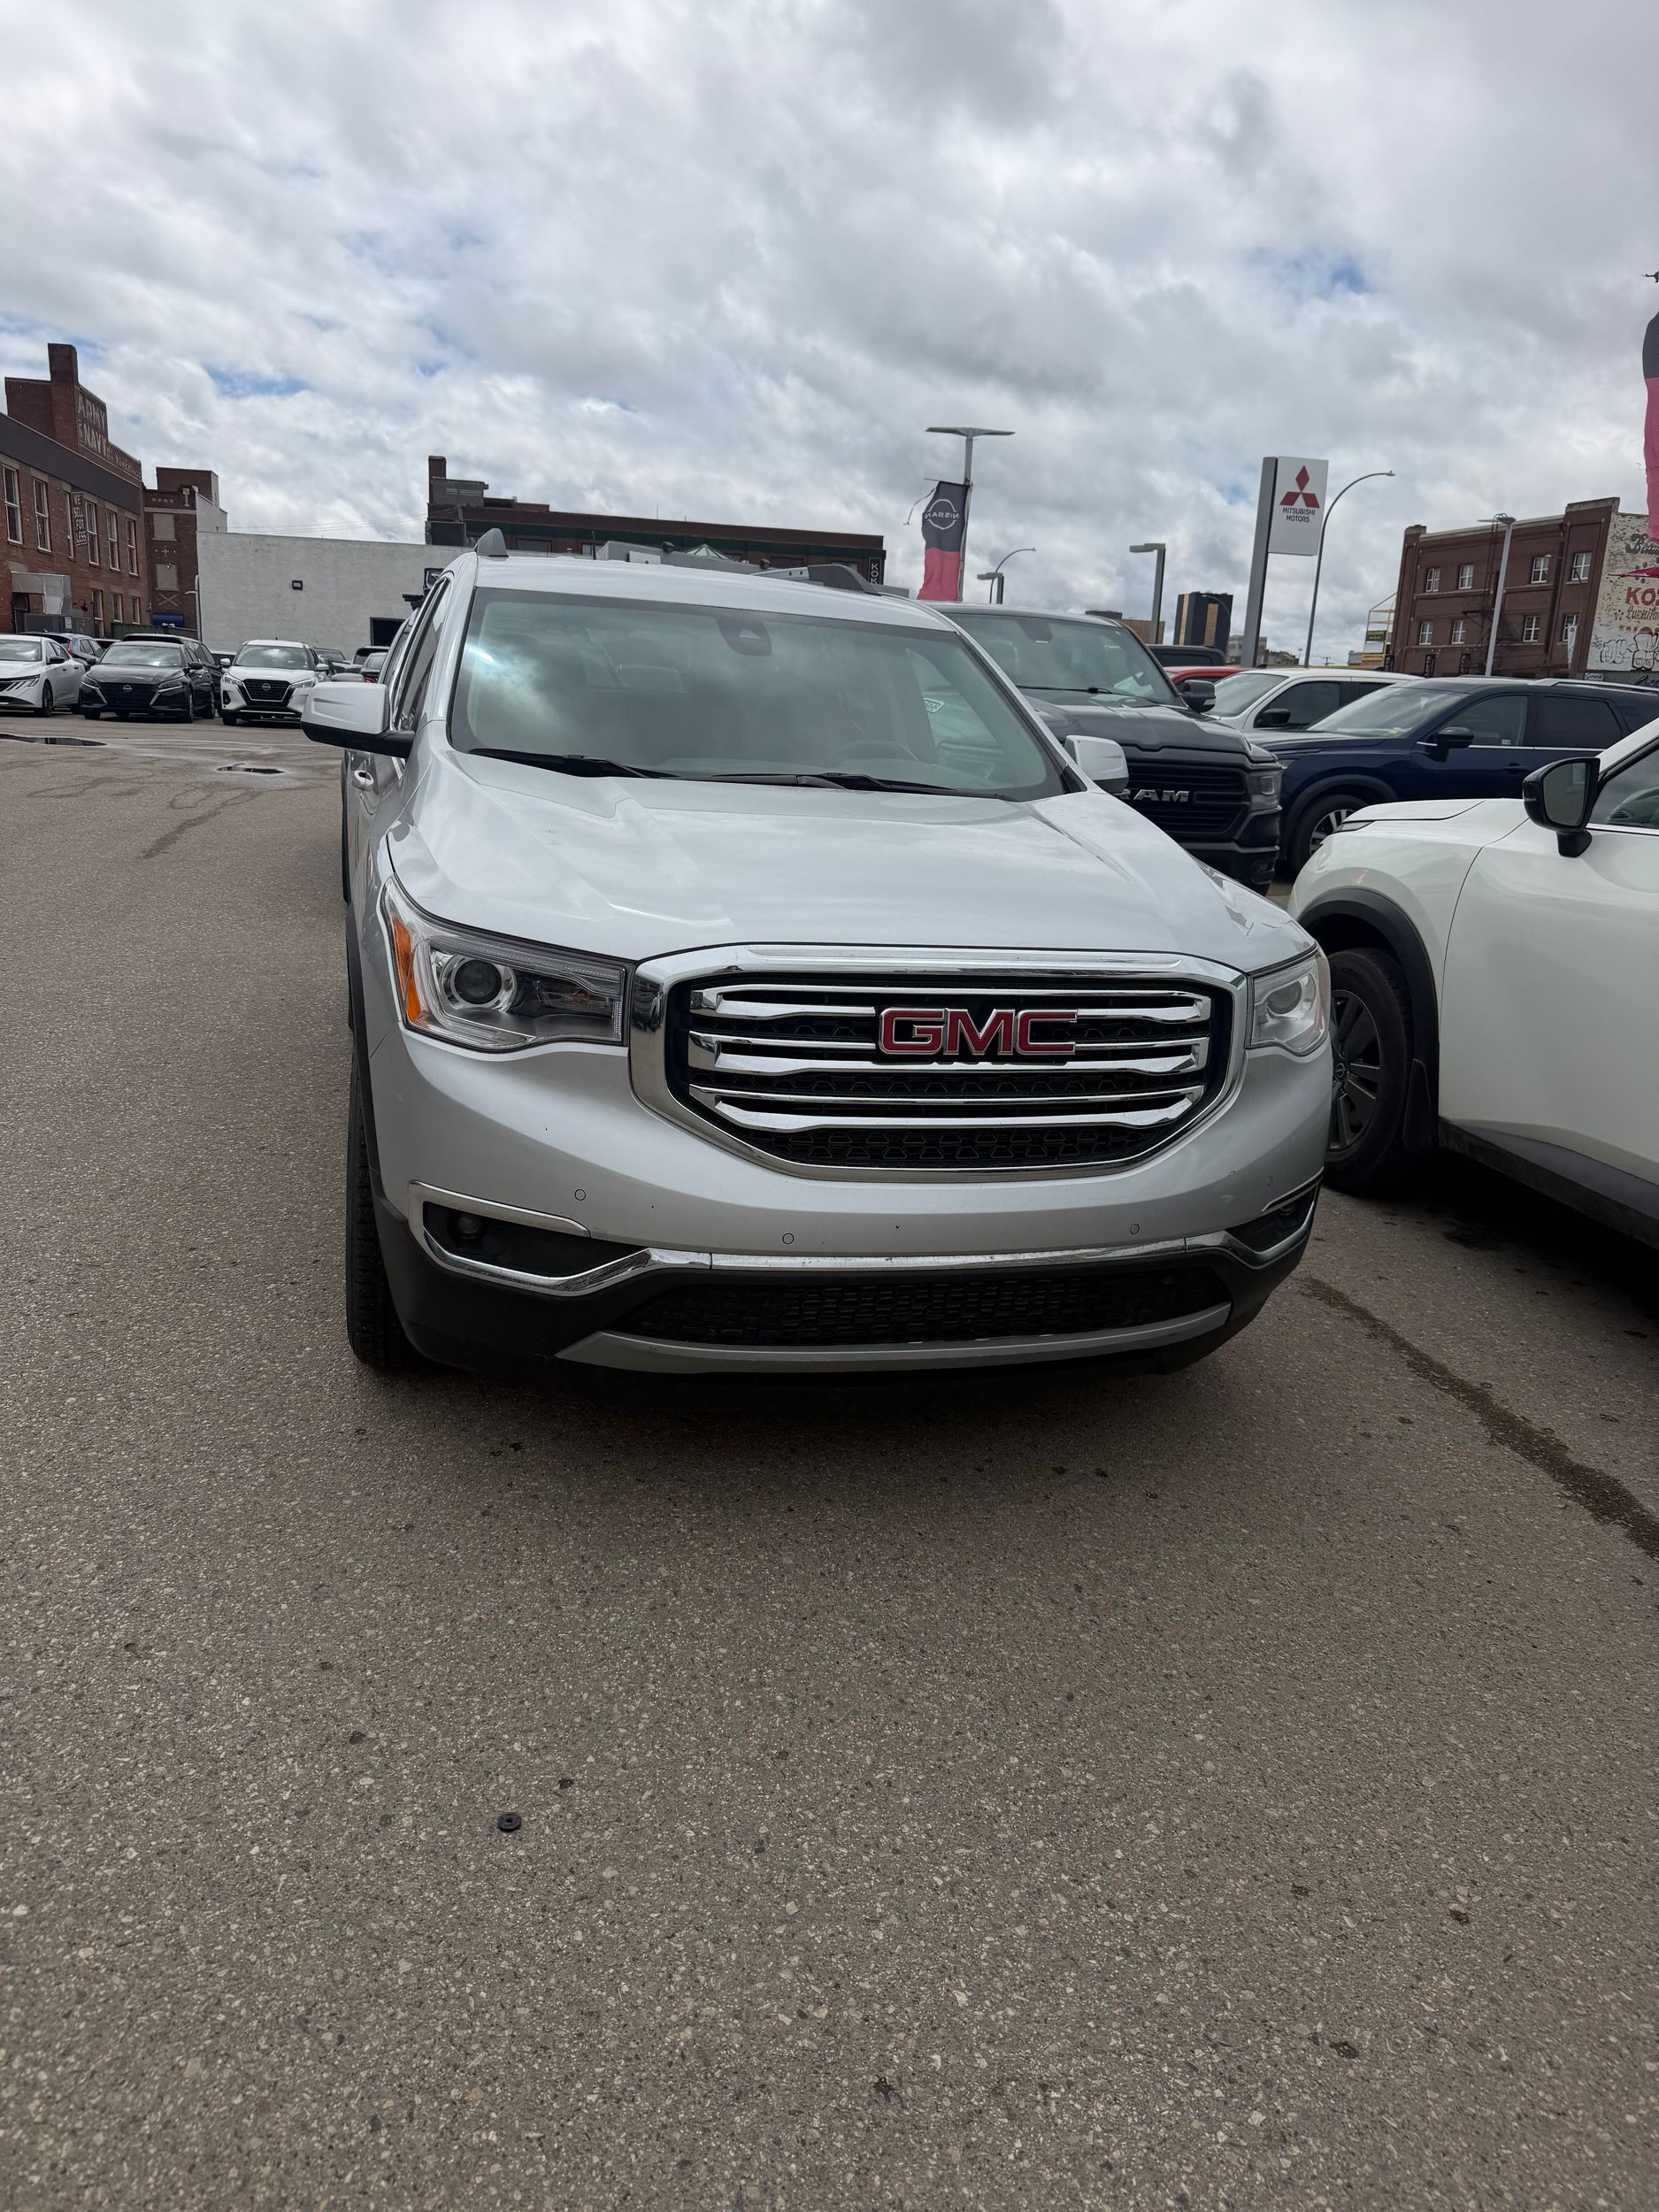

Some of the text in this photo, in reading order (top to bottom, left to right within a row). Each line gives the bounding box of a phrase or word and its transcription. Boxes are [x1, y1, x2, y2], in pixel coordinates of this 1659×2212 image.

[78, 394, 105, 431] ARMY
[84, 424, 106, 457] NAVY
[1283, 507, 1316, 516] MITSUBISHI
[76, 531, 87, 542] LESS
[1113, 788, 1189, 803] RAM
[879, 1008, 1078, 1055] GMC
